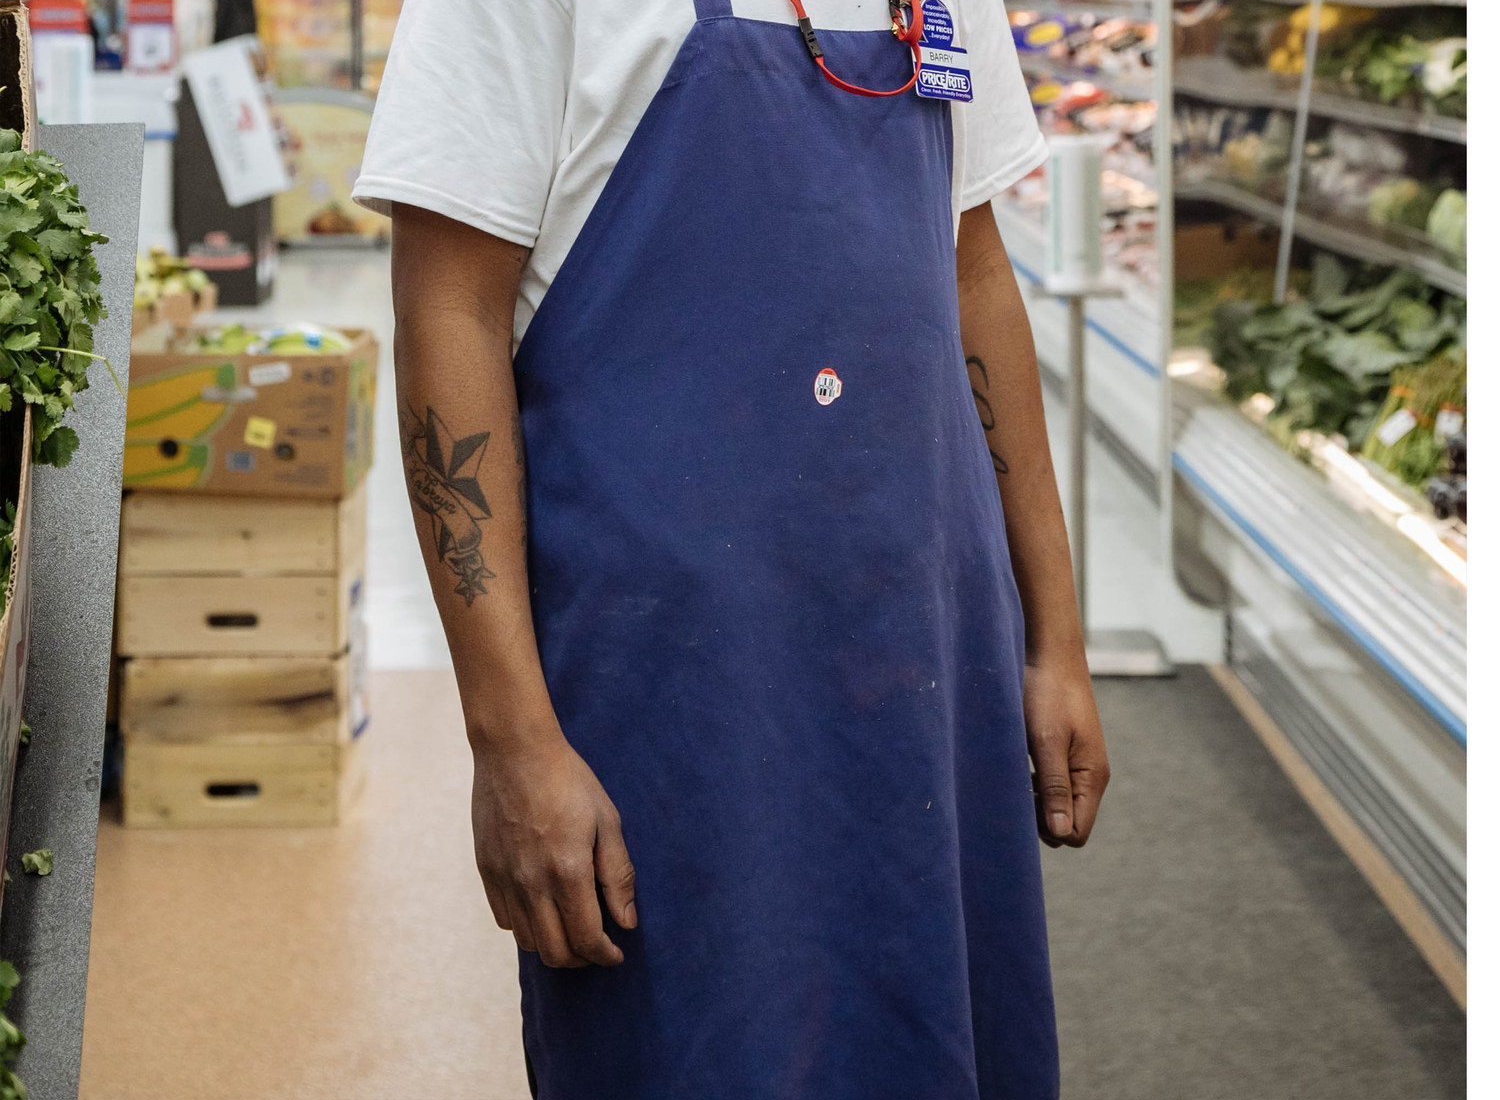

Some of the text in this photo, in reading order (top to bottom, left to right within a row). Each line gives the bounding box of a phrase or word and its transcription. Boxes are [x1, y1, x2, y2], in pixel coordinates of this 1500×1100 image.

[924, 24, 953, 35] LOW PRICES
[930, 52, 953, 64] BARRY
